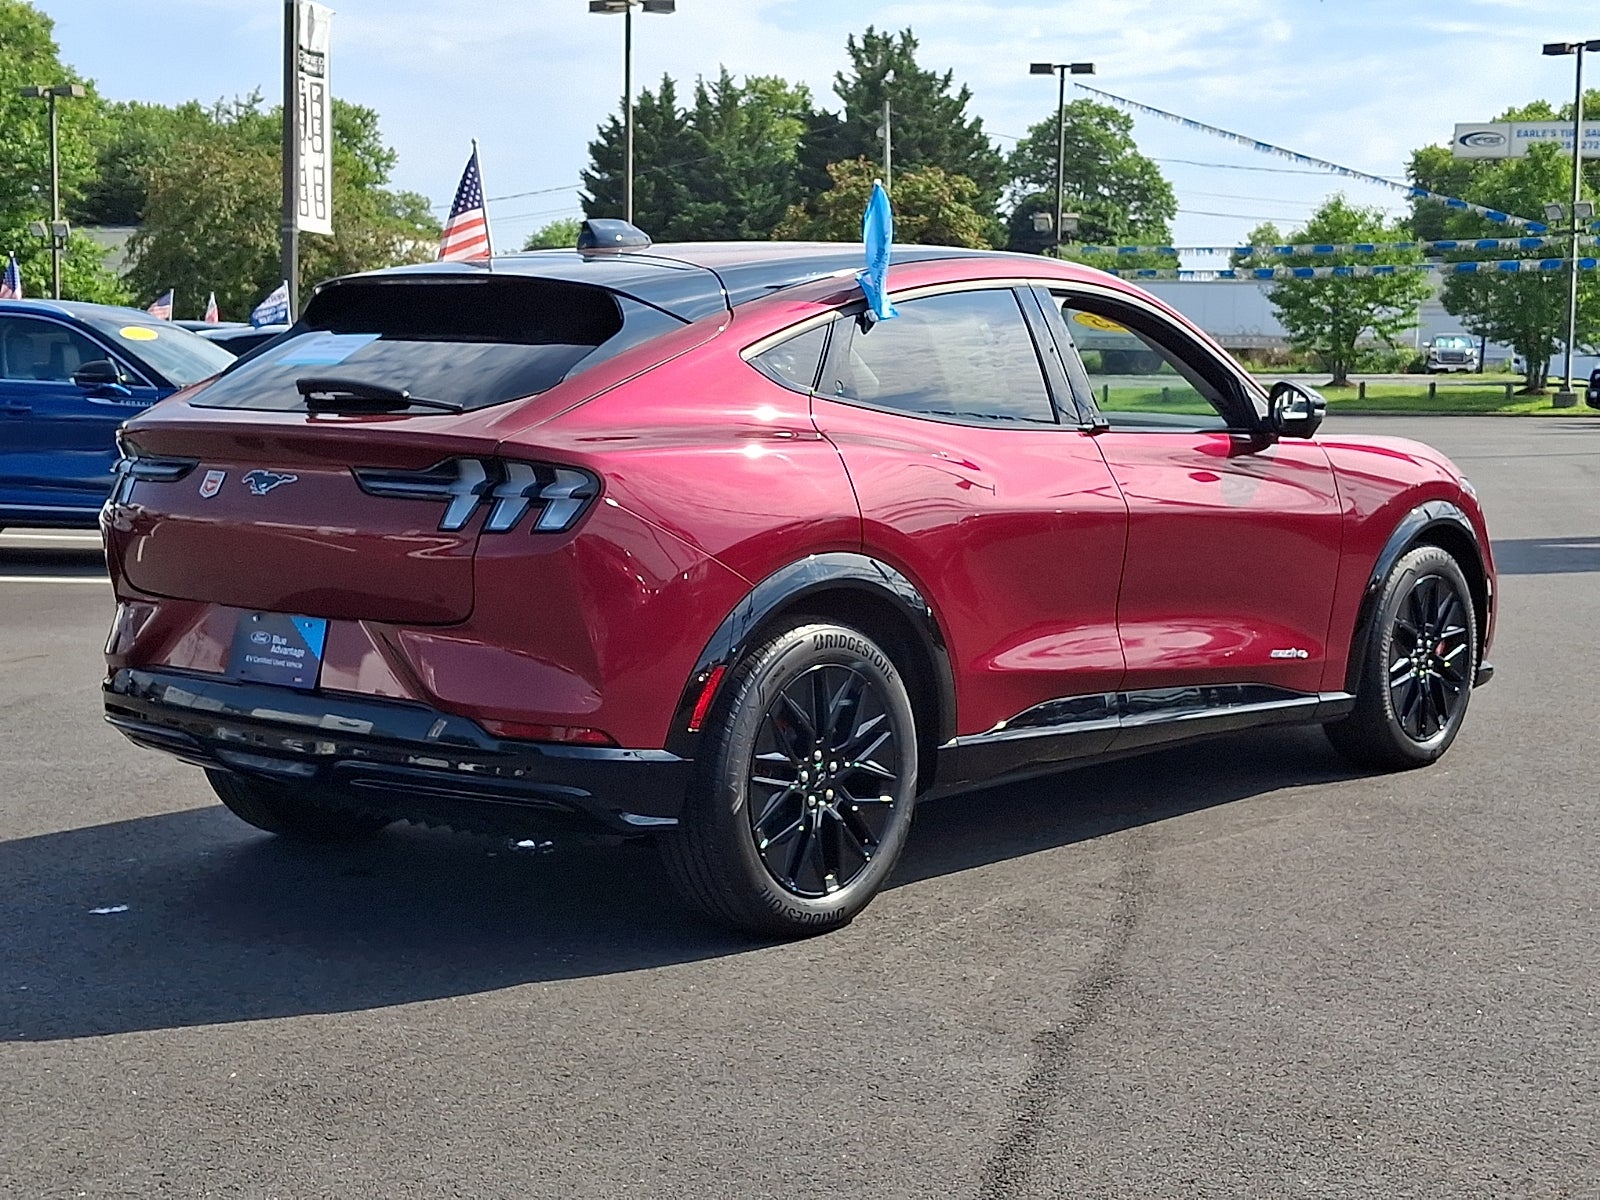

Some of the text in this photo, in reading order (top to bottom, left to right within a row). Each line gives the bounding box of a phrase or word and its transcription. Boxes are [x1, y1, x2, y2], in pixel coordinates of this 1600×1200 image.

[1516, 128, 1557, 138] EARLE'S
[272, 635, 287, 645] Blue
[270, 644, 305, 658] Advantage
[813, 633, 894, 684] BRIDGESTONE
